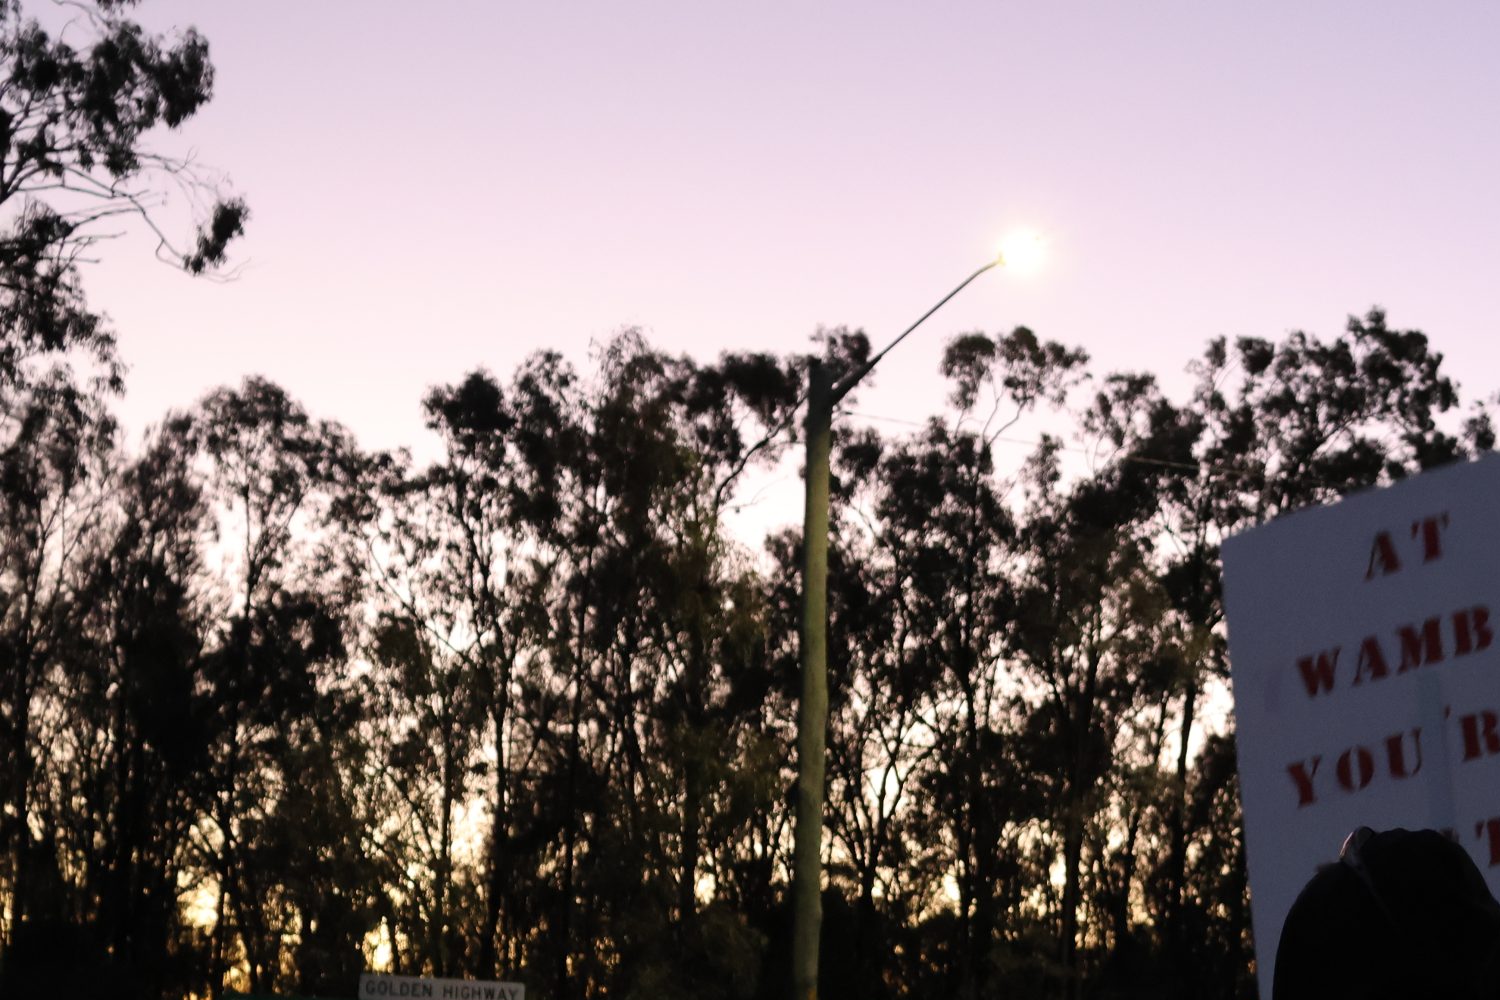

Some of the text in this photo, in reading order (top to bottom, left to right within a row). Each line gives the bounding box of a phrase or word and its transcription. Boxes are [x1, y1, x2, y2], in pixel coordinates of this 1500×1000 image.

[1364, 513, 1451, 581] AT
[366, 980, 519, 1000] GOLDEN HIGHWAY
